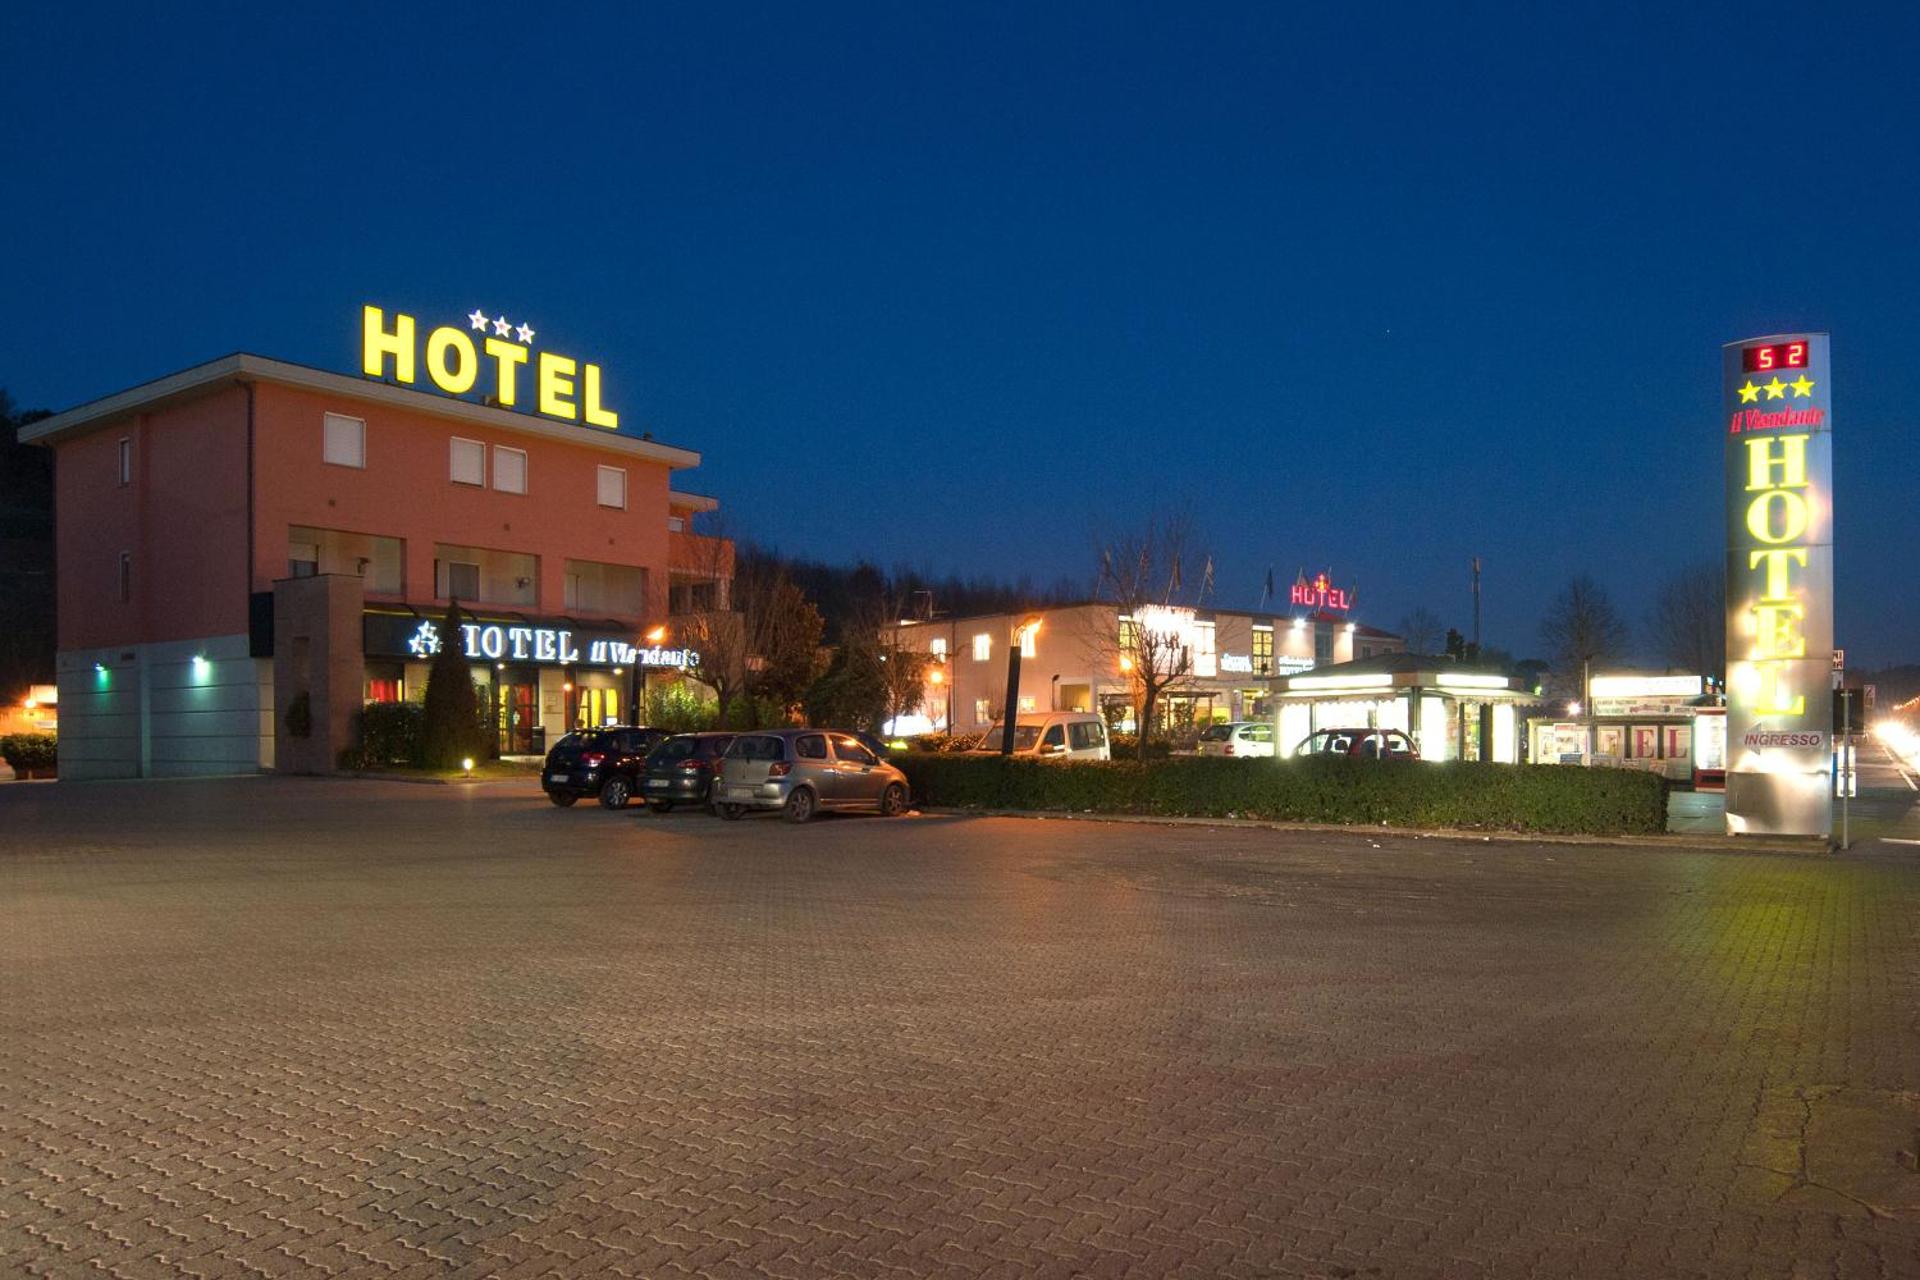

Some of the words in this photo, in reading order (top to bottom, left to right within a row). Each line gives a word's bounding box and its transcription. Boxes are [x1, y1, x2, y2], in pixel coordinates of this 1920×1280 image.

[363, 305, 619, 429] HOTEL
[1291, 584, 1350, 610] HOTEL
[1744, 433, 1809, 716] HOTEL
[1743, 734, 1820, 746] INGRESSO
